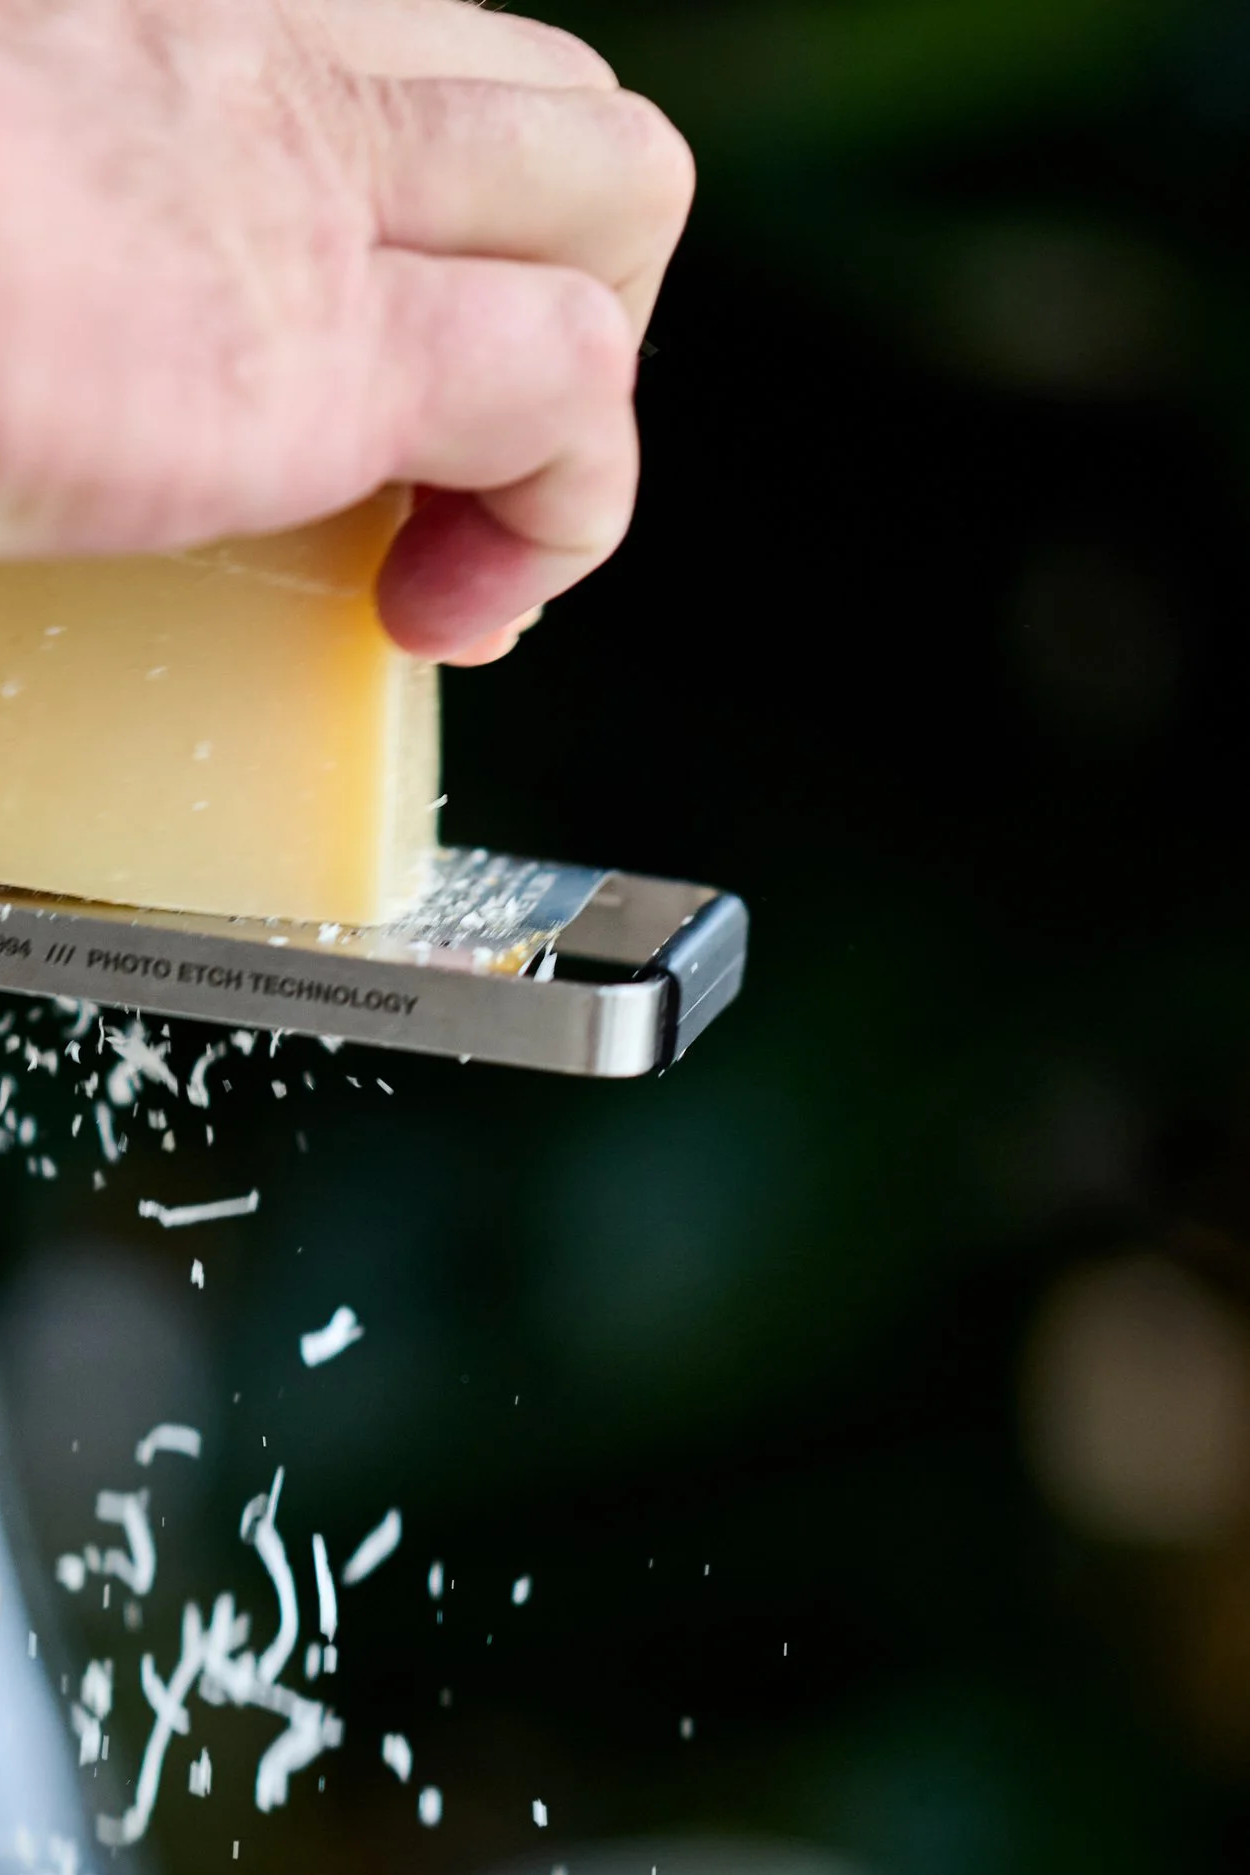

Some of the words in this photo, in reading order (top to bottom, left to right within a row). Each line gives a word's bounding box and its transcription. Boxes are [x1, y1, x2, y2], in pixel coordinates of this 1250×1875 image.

[86, 948, 172, 979] PHOTO
[176, 961, 245, 992] ETCH
[248, 971, 420, 1017] TECHNOLOGY
